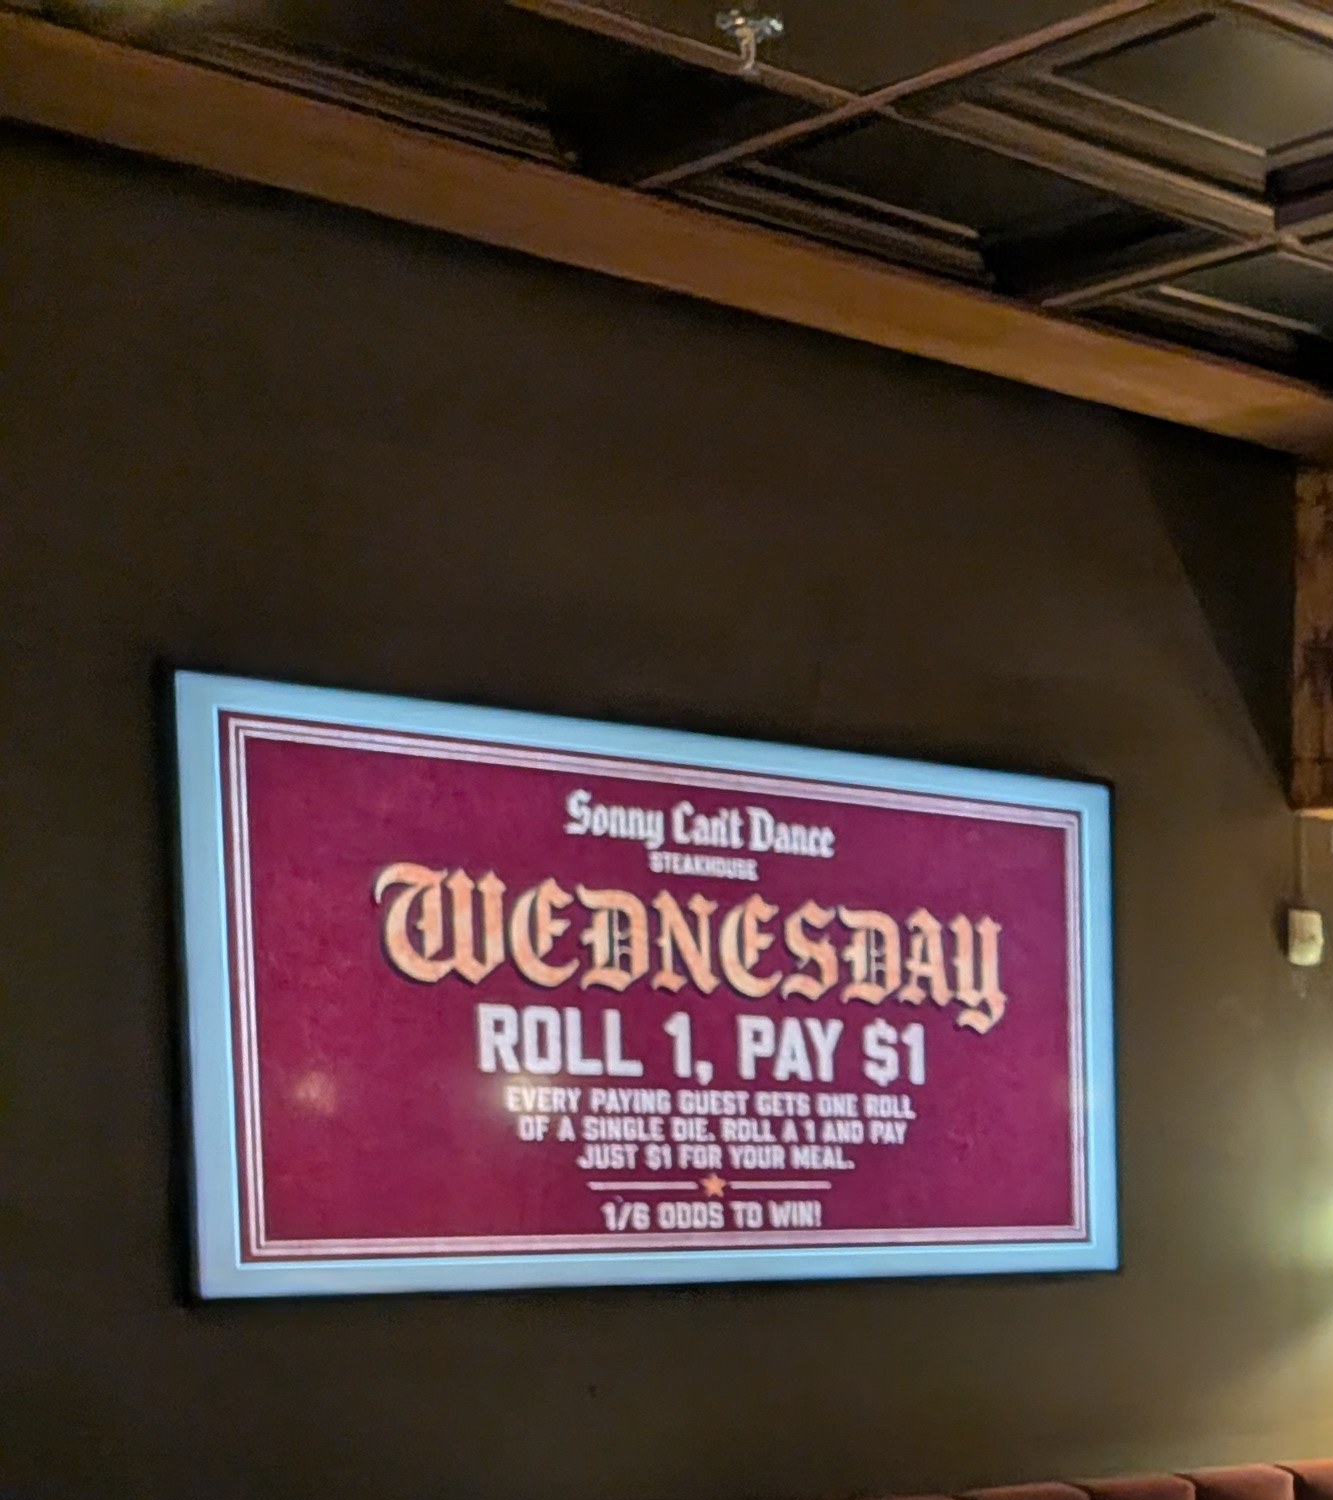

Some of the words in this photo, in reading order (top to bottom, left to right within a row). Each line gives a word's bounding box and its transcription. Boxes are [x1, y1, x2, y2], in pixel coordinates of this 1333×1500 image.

[563, 788, 665, 851] Sonny
[746, 805, 835, 858] Dance
[648, 850, 759, 882] STEAKHOUSE
[373, 862, 1007, 1034] WEDNESDAY
[477, 1003, 643, 1077] ROLL
[663, 1011, 714, 1086] 1,
[737, 1014, 843, 1082] PAY
[863, 1018, 927, 1087] $1
[504, 1085, 582, 1113] EVERY
[589, 1087, 672, 1115] PAYING
[677, 1089, 750, 1116] GUEST
[754, 1091, 811, 1117] GETS
[815, 1093, 859, 1118] ONE
[863, 1093, 917, 1119] ROLL
[517, 1114, 550, 1142] OF
[556, 1115, 577, 1142] A
[582, 1115, 666, 1142] SINGLE
[671, 1117, 716, 1142] DIE.
[719, 1117, 777, 1142] ROLL
[781, 1118, 799, 1143] A
[802, 1118, 816, 1143] 1
[822, 1119, 864, 1144] AND
[869, 1120, 908, 1145] PAY
[576, 1143, 639, 1170] JUST
[645, 1143, 673, 1171] $1
[678, 1144, 723, 1170] FOR
[726, 1144, 786, 1170] YOUR
[789, 1146, 856, 1170] MEAL.
[601, 1199, 651, 1231] 1/6
[655, 1200, 725, 1230] ODDS
[729, 1200, 764, 1229] TO
[768, 1200, 822, 1228] WIN!
